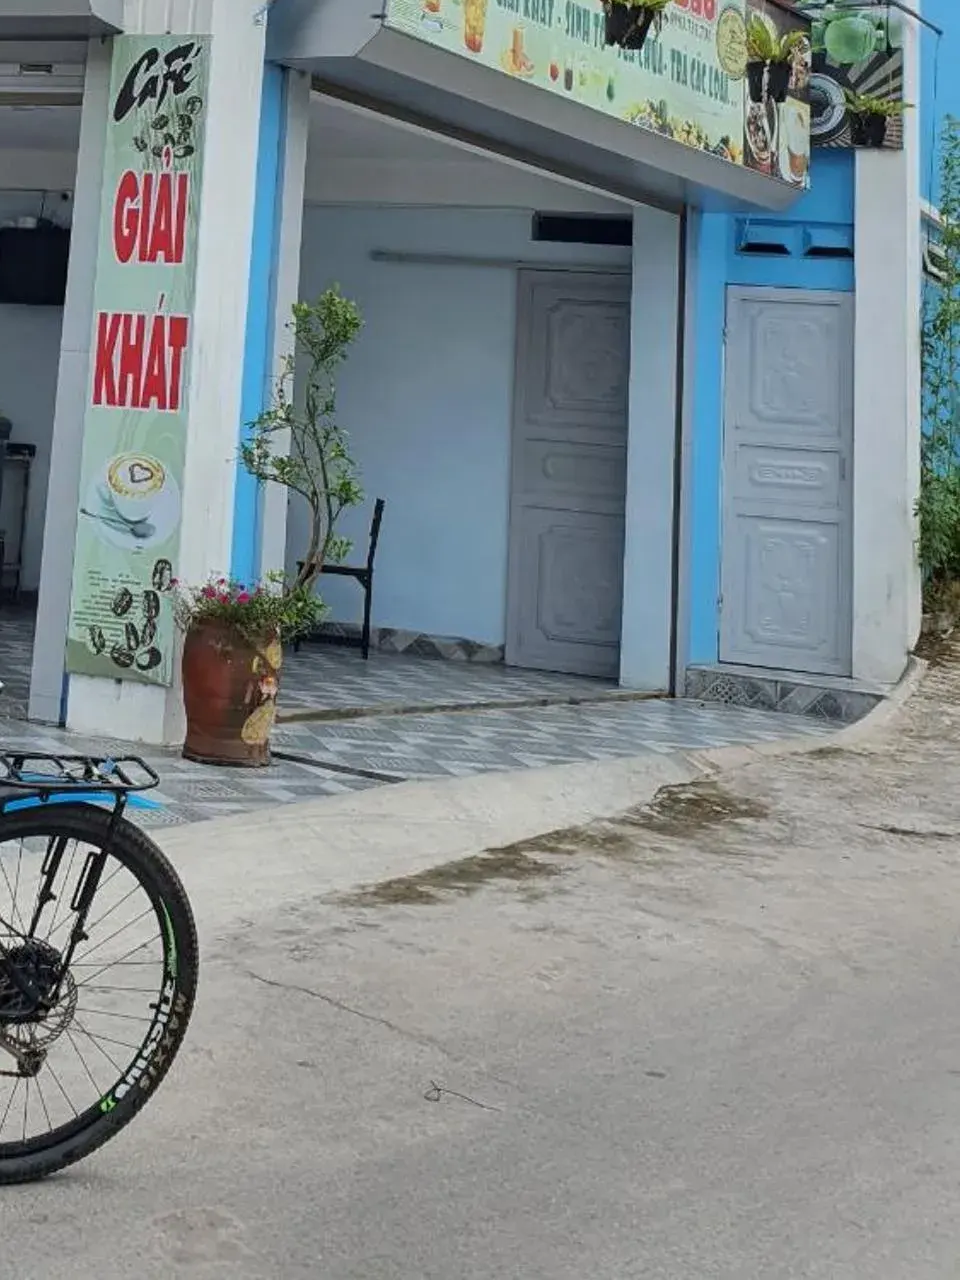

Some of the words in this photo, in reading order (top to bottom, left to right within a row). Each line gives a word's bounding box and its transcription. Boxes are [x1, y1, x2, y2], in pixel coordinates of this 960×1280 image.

[565, 0, 591, 45] SINH
[690, 53, 707, 95] CÁC
[111, 147, 190, 264] GIẢI
[91, 295, 190, 411] KHÁT
